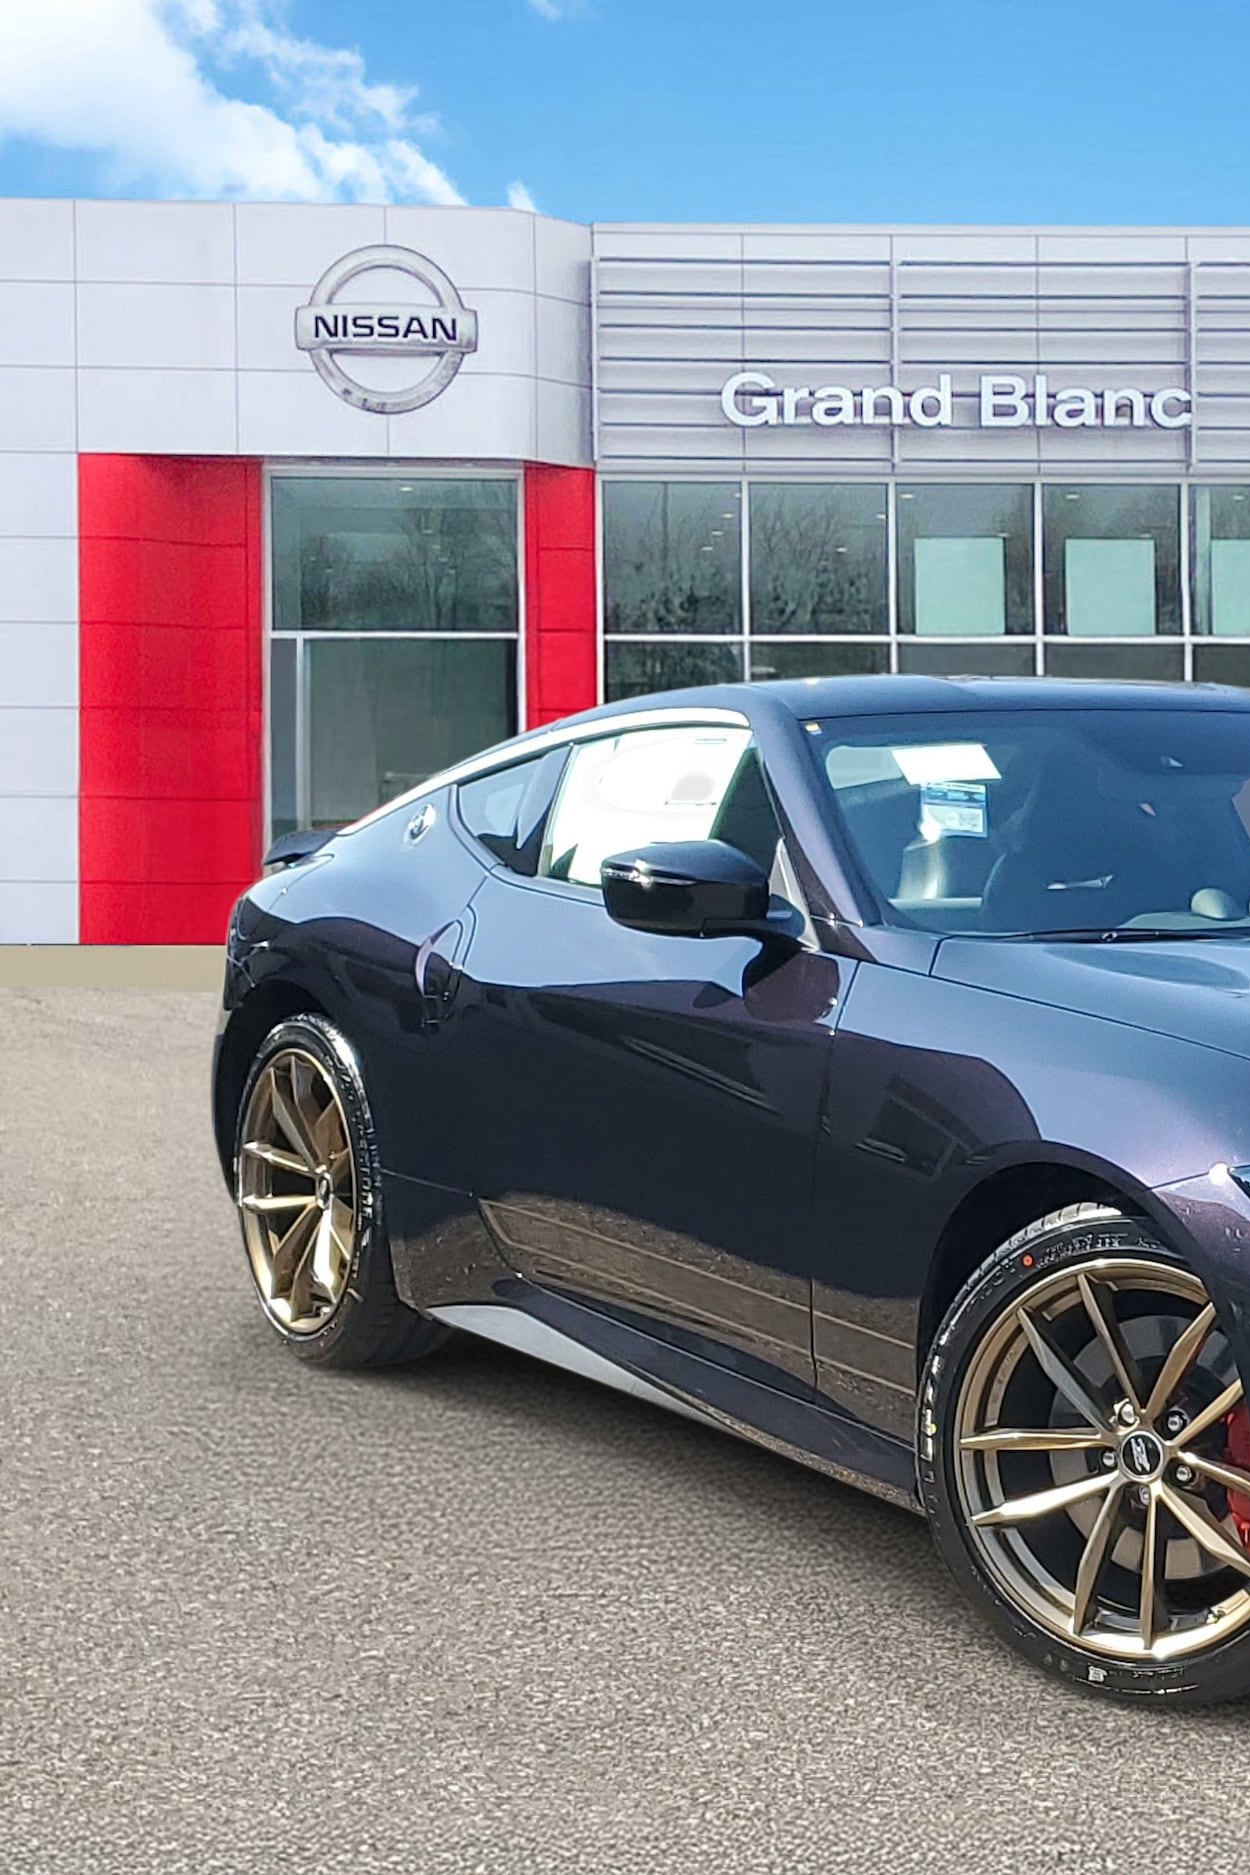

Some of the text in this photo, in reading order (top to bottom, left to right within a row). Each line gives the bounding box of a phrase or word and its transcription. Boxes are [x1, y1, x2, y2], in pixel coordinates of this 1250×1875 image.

[314, 315, 457, 341] NISSAN
[720, 372, 1192, 428] Grand Blanc
